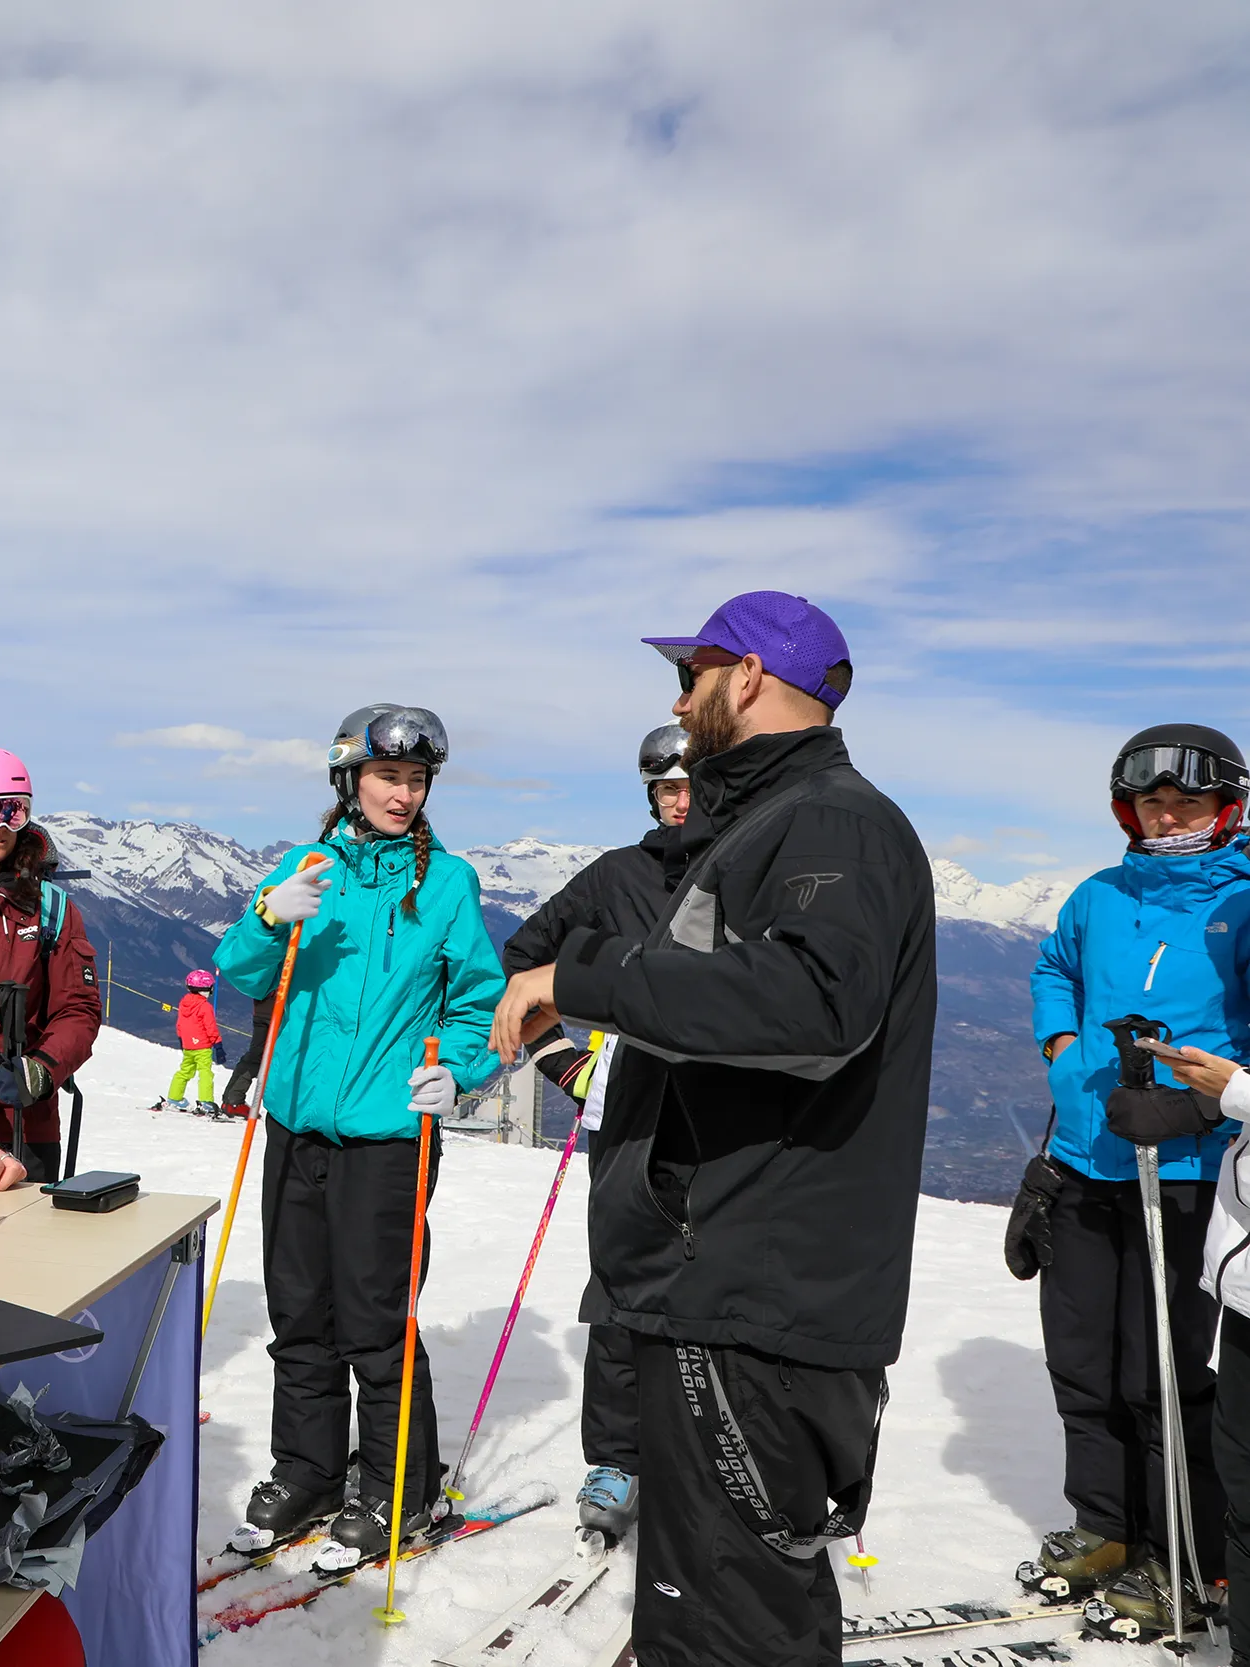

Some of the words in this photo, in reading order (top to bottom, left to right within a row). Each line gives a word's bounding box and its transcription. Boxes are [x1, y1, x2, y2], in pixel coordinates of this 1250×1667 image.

[1239, 776, 1250, 788] an
[715, 1433, 772, 1521] seasons
[716, 1459, 745, 1501] five
